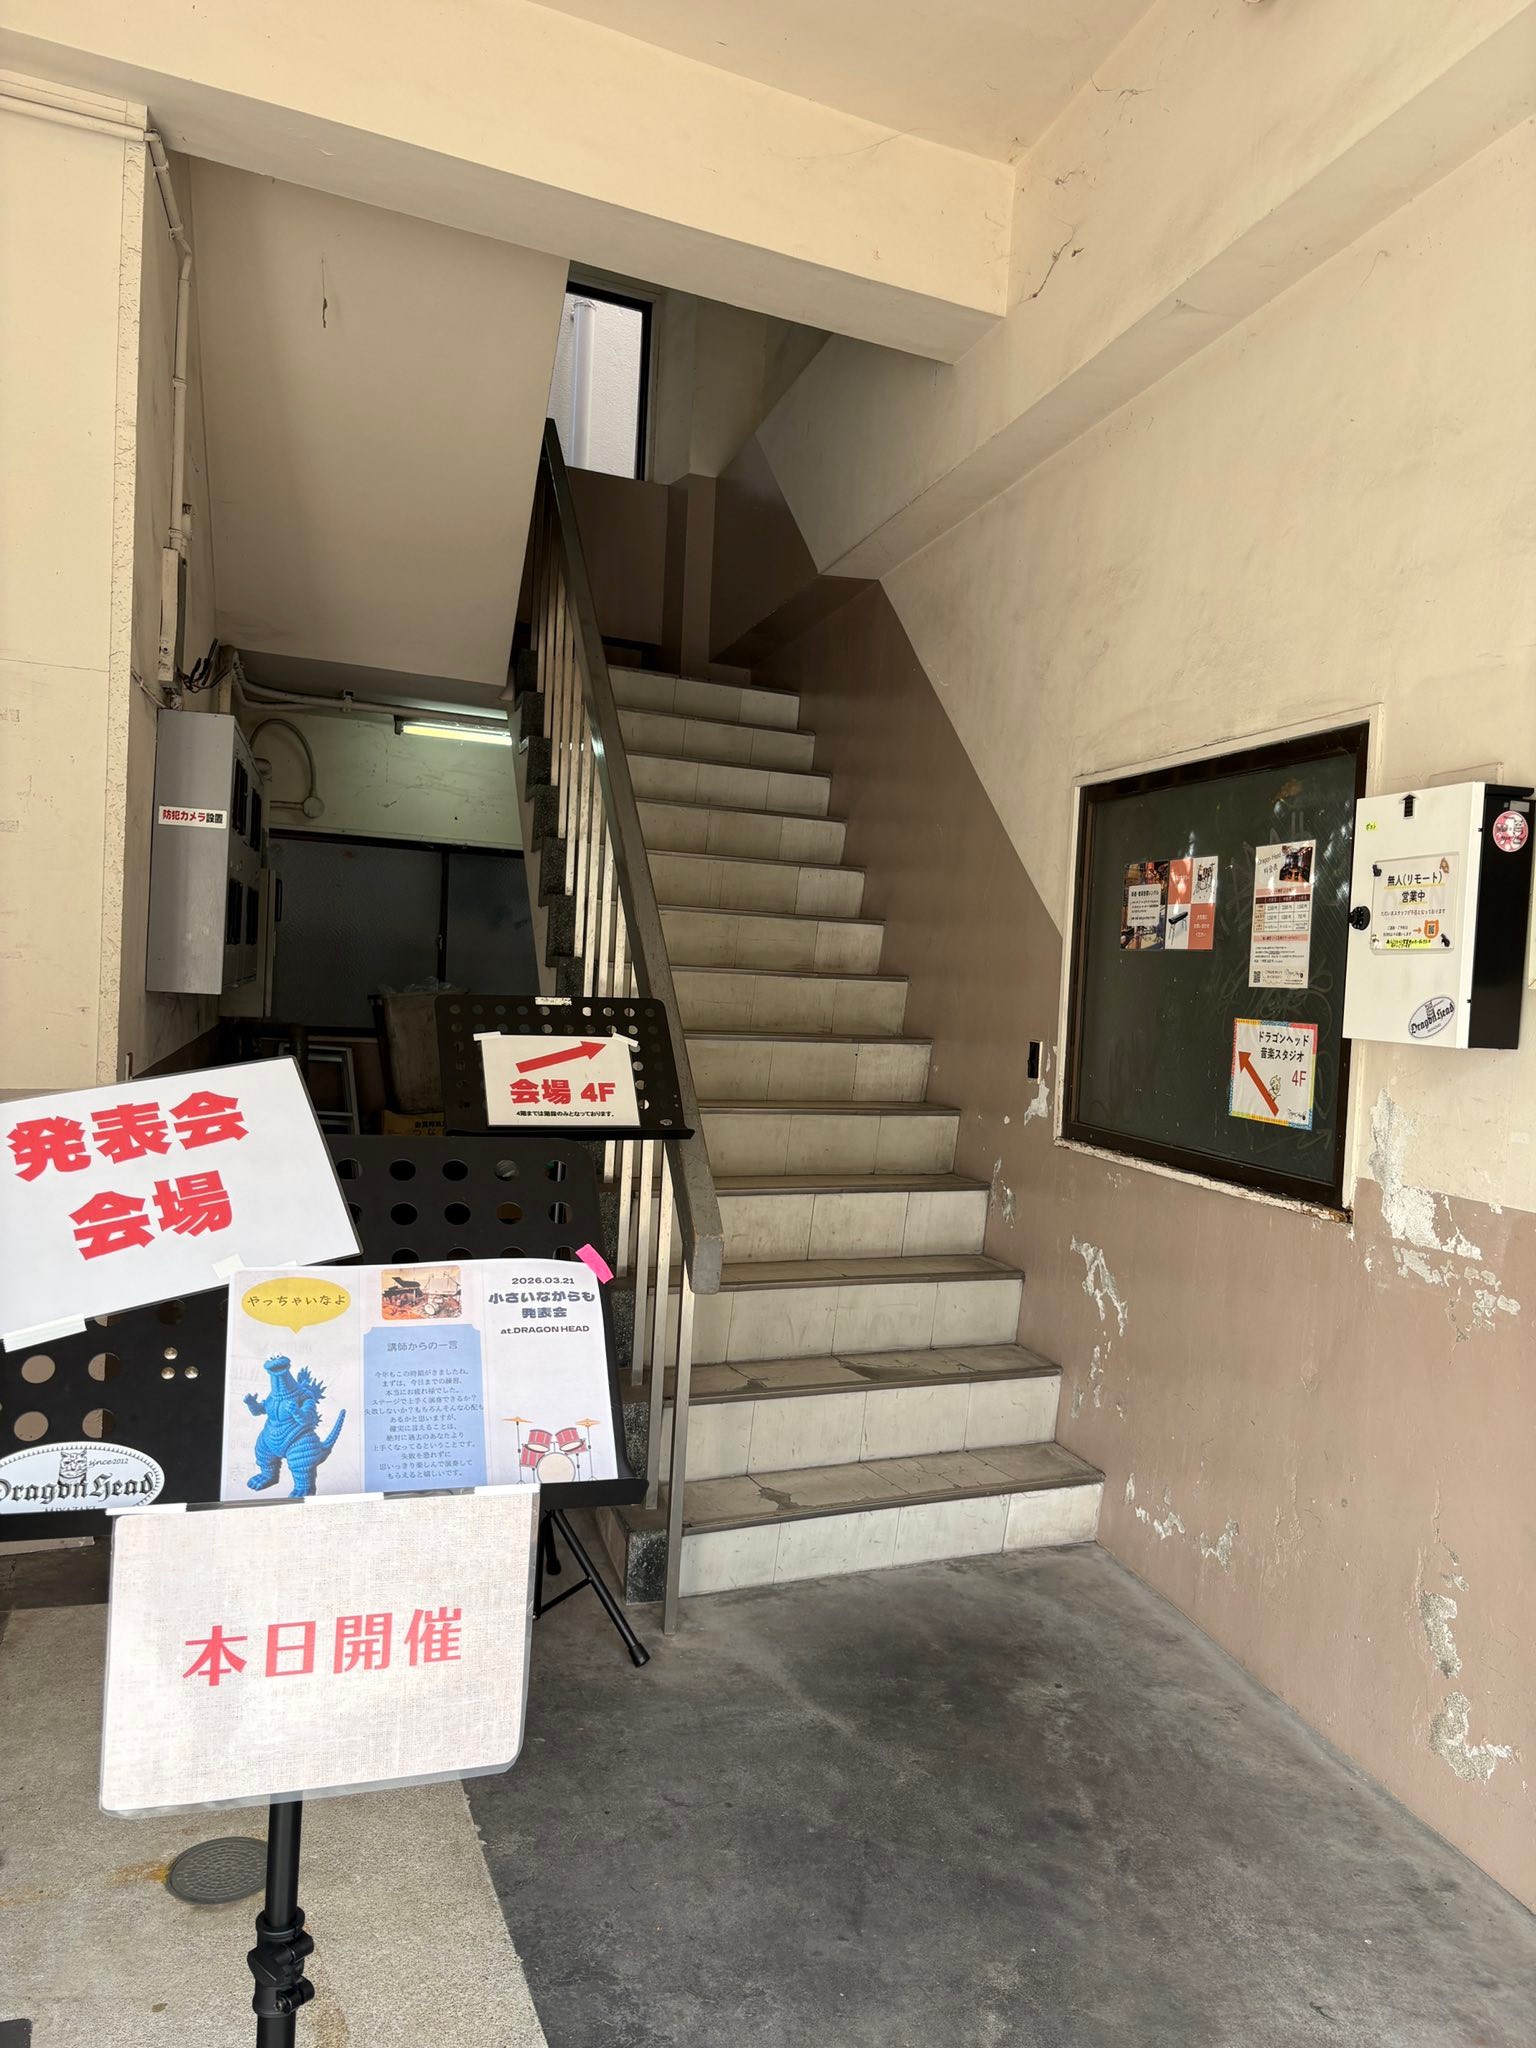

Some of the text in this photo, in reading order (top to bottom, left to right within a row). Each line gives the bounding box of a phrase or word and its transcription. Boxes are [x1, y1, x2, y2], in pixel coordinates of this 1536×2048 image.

[162, 809, 224, 824] 防犯カメラ設置
[1386, 870, 1443, 887] 無人(リモート)
[1401, 890, 1426, 903] 営業中
[1259, 1031, 1310, 1047] ドラゴンヘッド
[1260, 1047, 1305, 1062] 音楽スタジオ
[1291, 1069, 1307, 1087] 4F
[509, 1078, 616, 1105] 会場 4F
[6, 1090, 250, 1182] 発表会
[69, 1170, 233, 1261] 会場
[511, 1277, 575, 1285] 2026.03.21
[247, 1294, 346, 1307] やっちゃいなよ
[488, 1290, 596, 1304] 小さいながらも
[521, 1306, 567, 1318] 発表会
[560, 1325, 590, 1333] HEAD
[386, 1340, 459, 1352] 講師からの一言
[88, 1471, 154, 1502] Head
[182, 1606, 462, 1686] 本日開催
